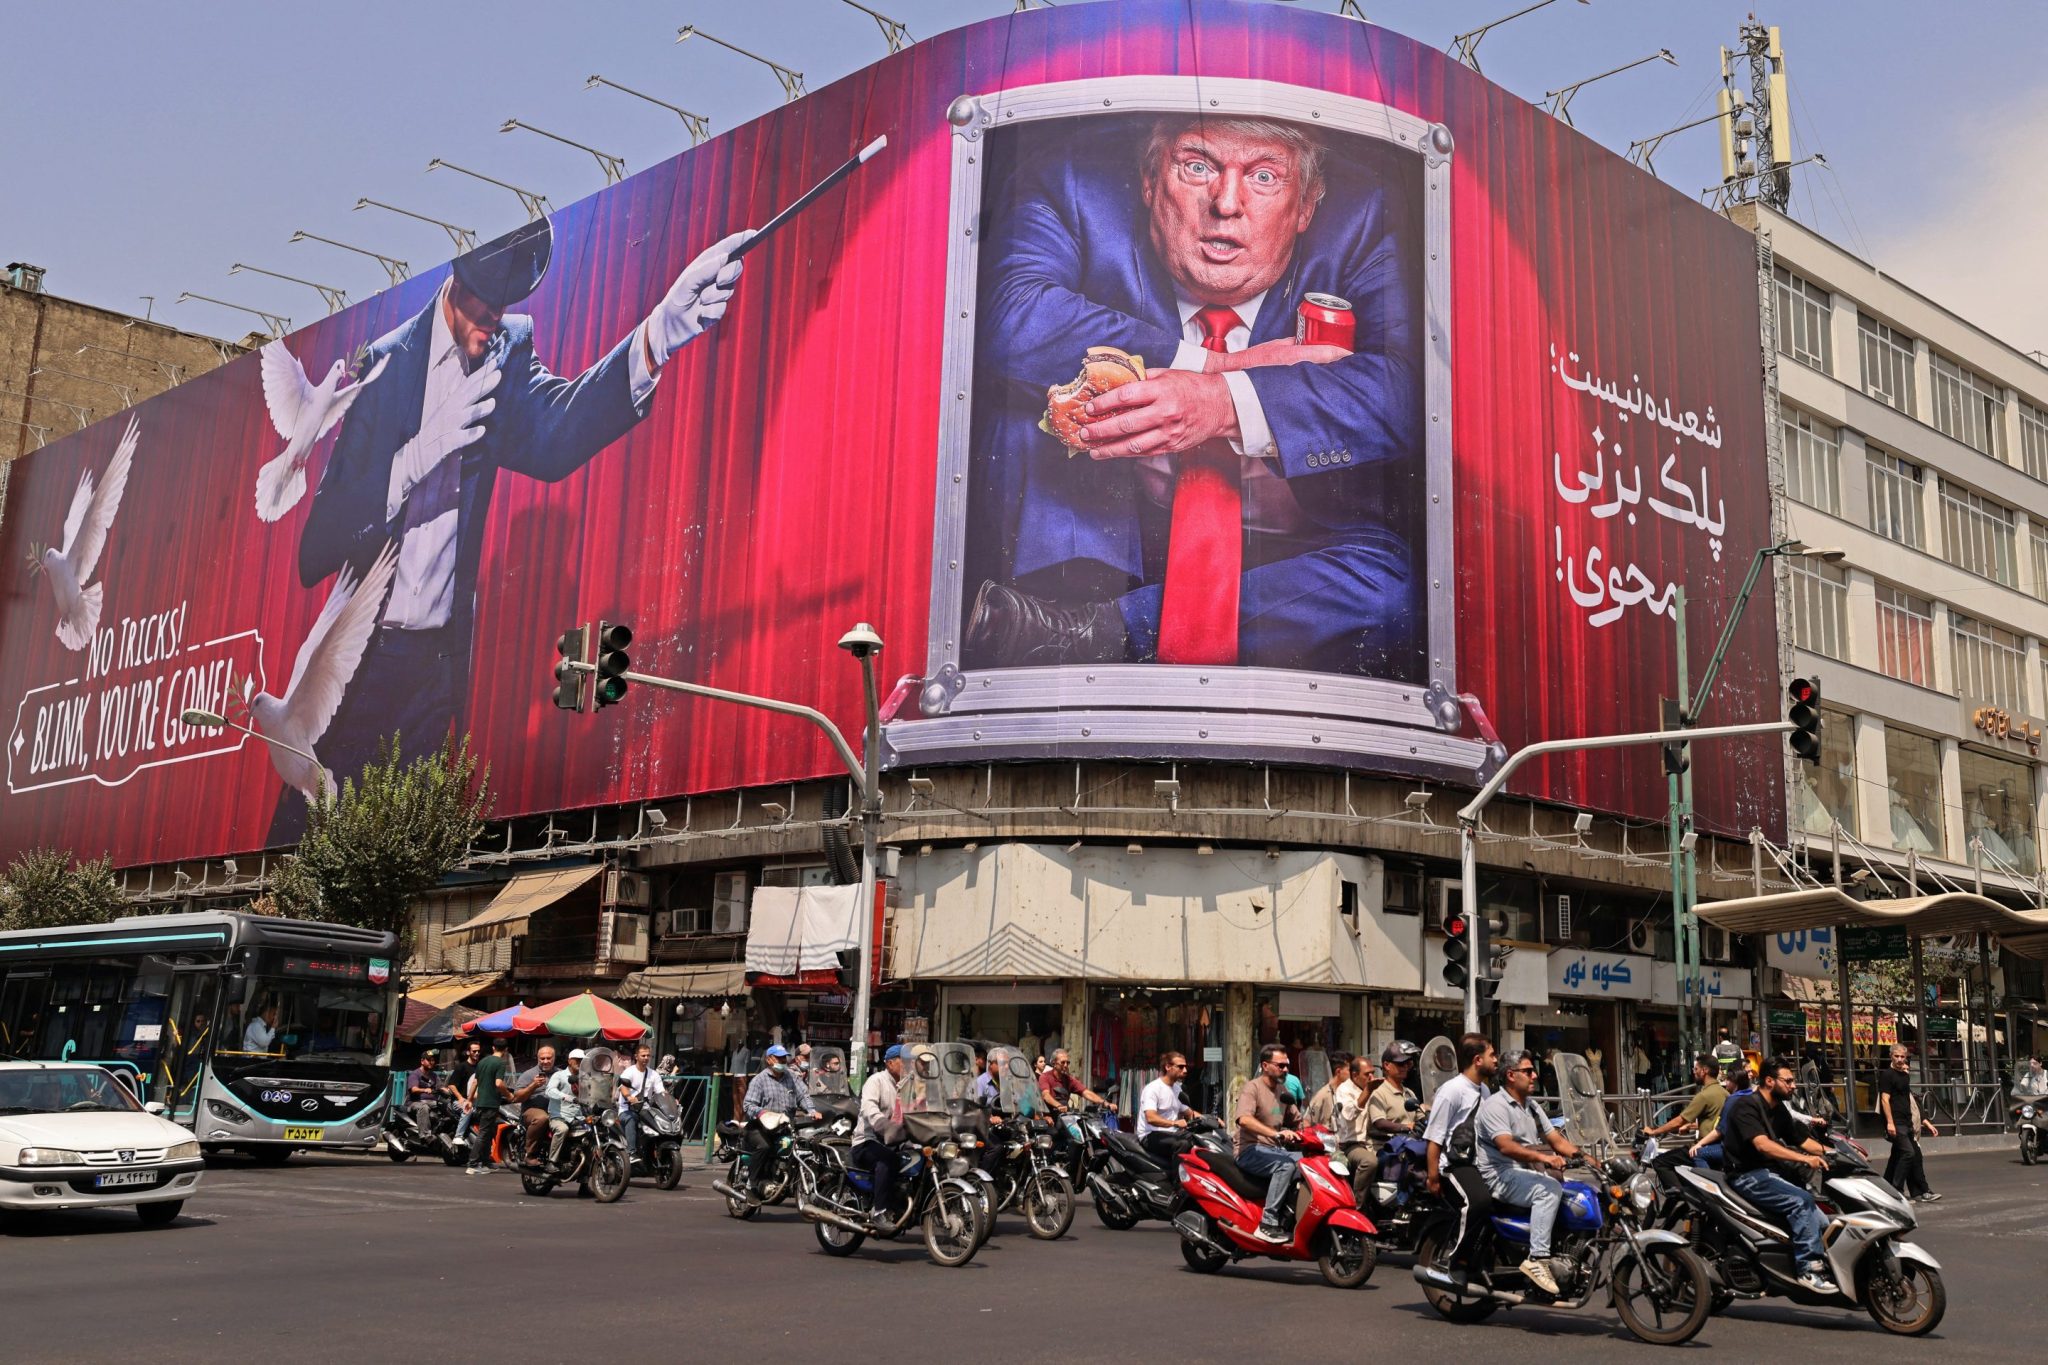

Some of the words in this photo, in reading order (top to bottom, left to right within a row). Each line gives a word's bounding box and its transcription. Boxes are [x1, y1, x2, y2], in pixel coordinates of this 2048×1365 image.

[1645, 392, 1722, 449] شعبده
[1554, 425, 1642, 525] بزنی
[1648, 453, 1726, 562] پلک
[86, 627, 115, 682] NO
[118, 600, 187, 670] TRICKS!
[30, 692, 91, 775] BLINK,
[96, 676, 164, 760] YOU'RE
[163, 657, 234, 748] GONE!
[1563, 955, 1586, 988] نور
[1592, 958, 1632, 991] کوه
